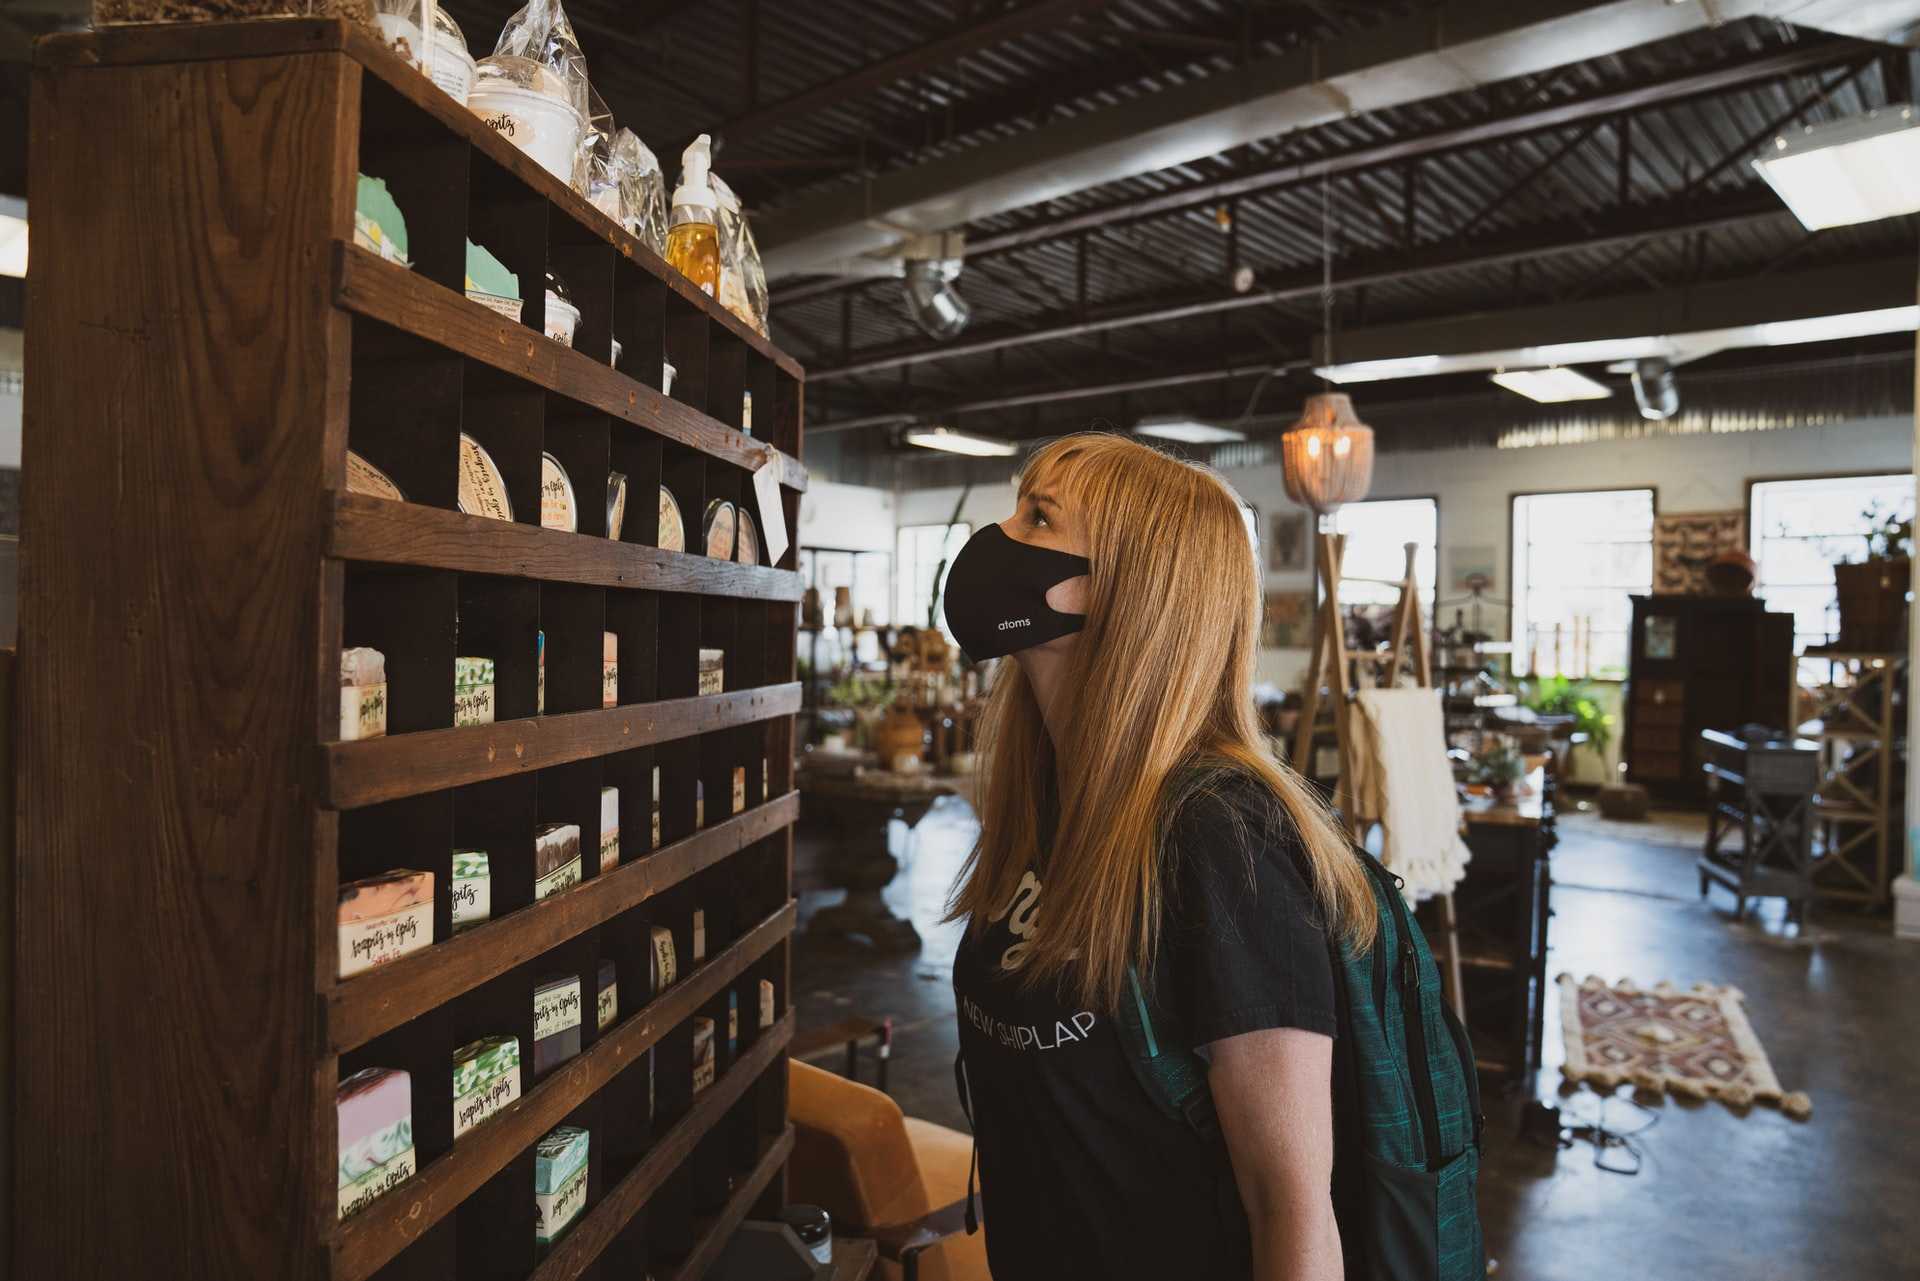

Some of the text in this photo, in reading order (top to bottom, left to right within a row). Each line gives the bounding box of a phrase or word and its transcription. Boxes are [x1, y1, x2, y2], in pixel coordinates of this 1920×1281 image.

[998, 618, 1031, 631] atoms
[963, 997, 1095, 1051] NEW SHIPLAP
